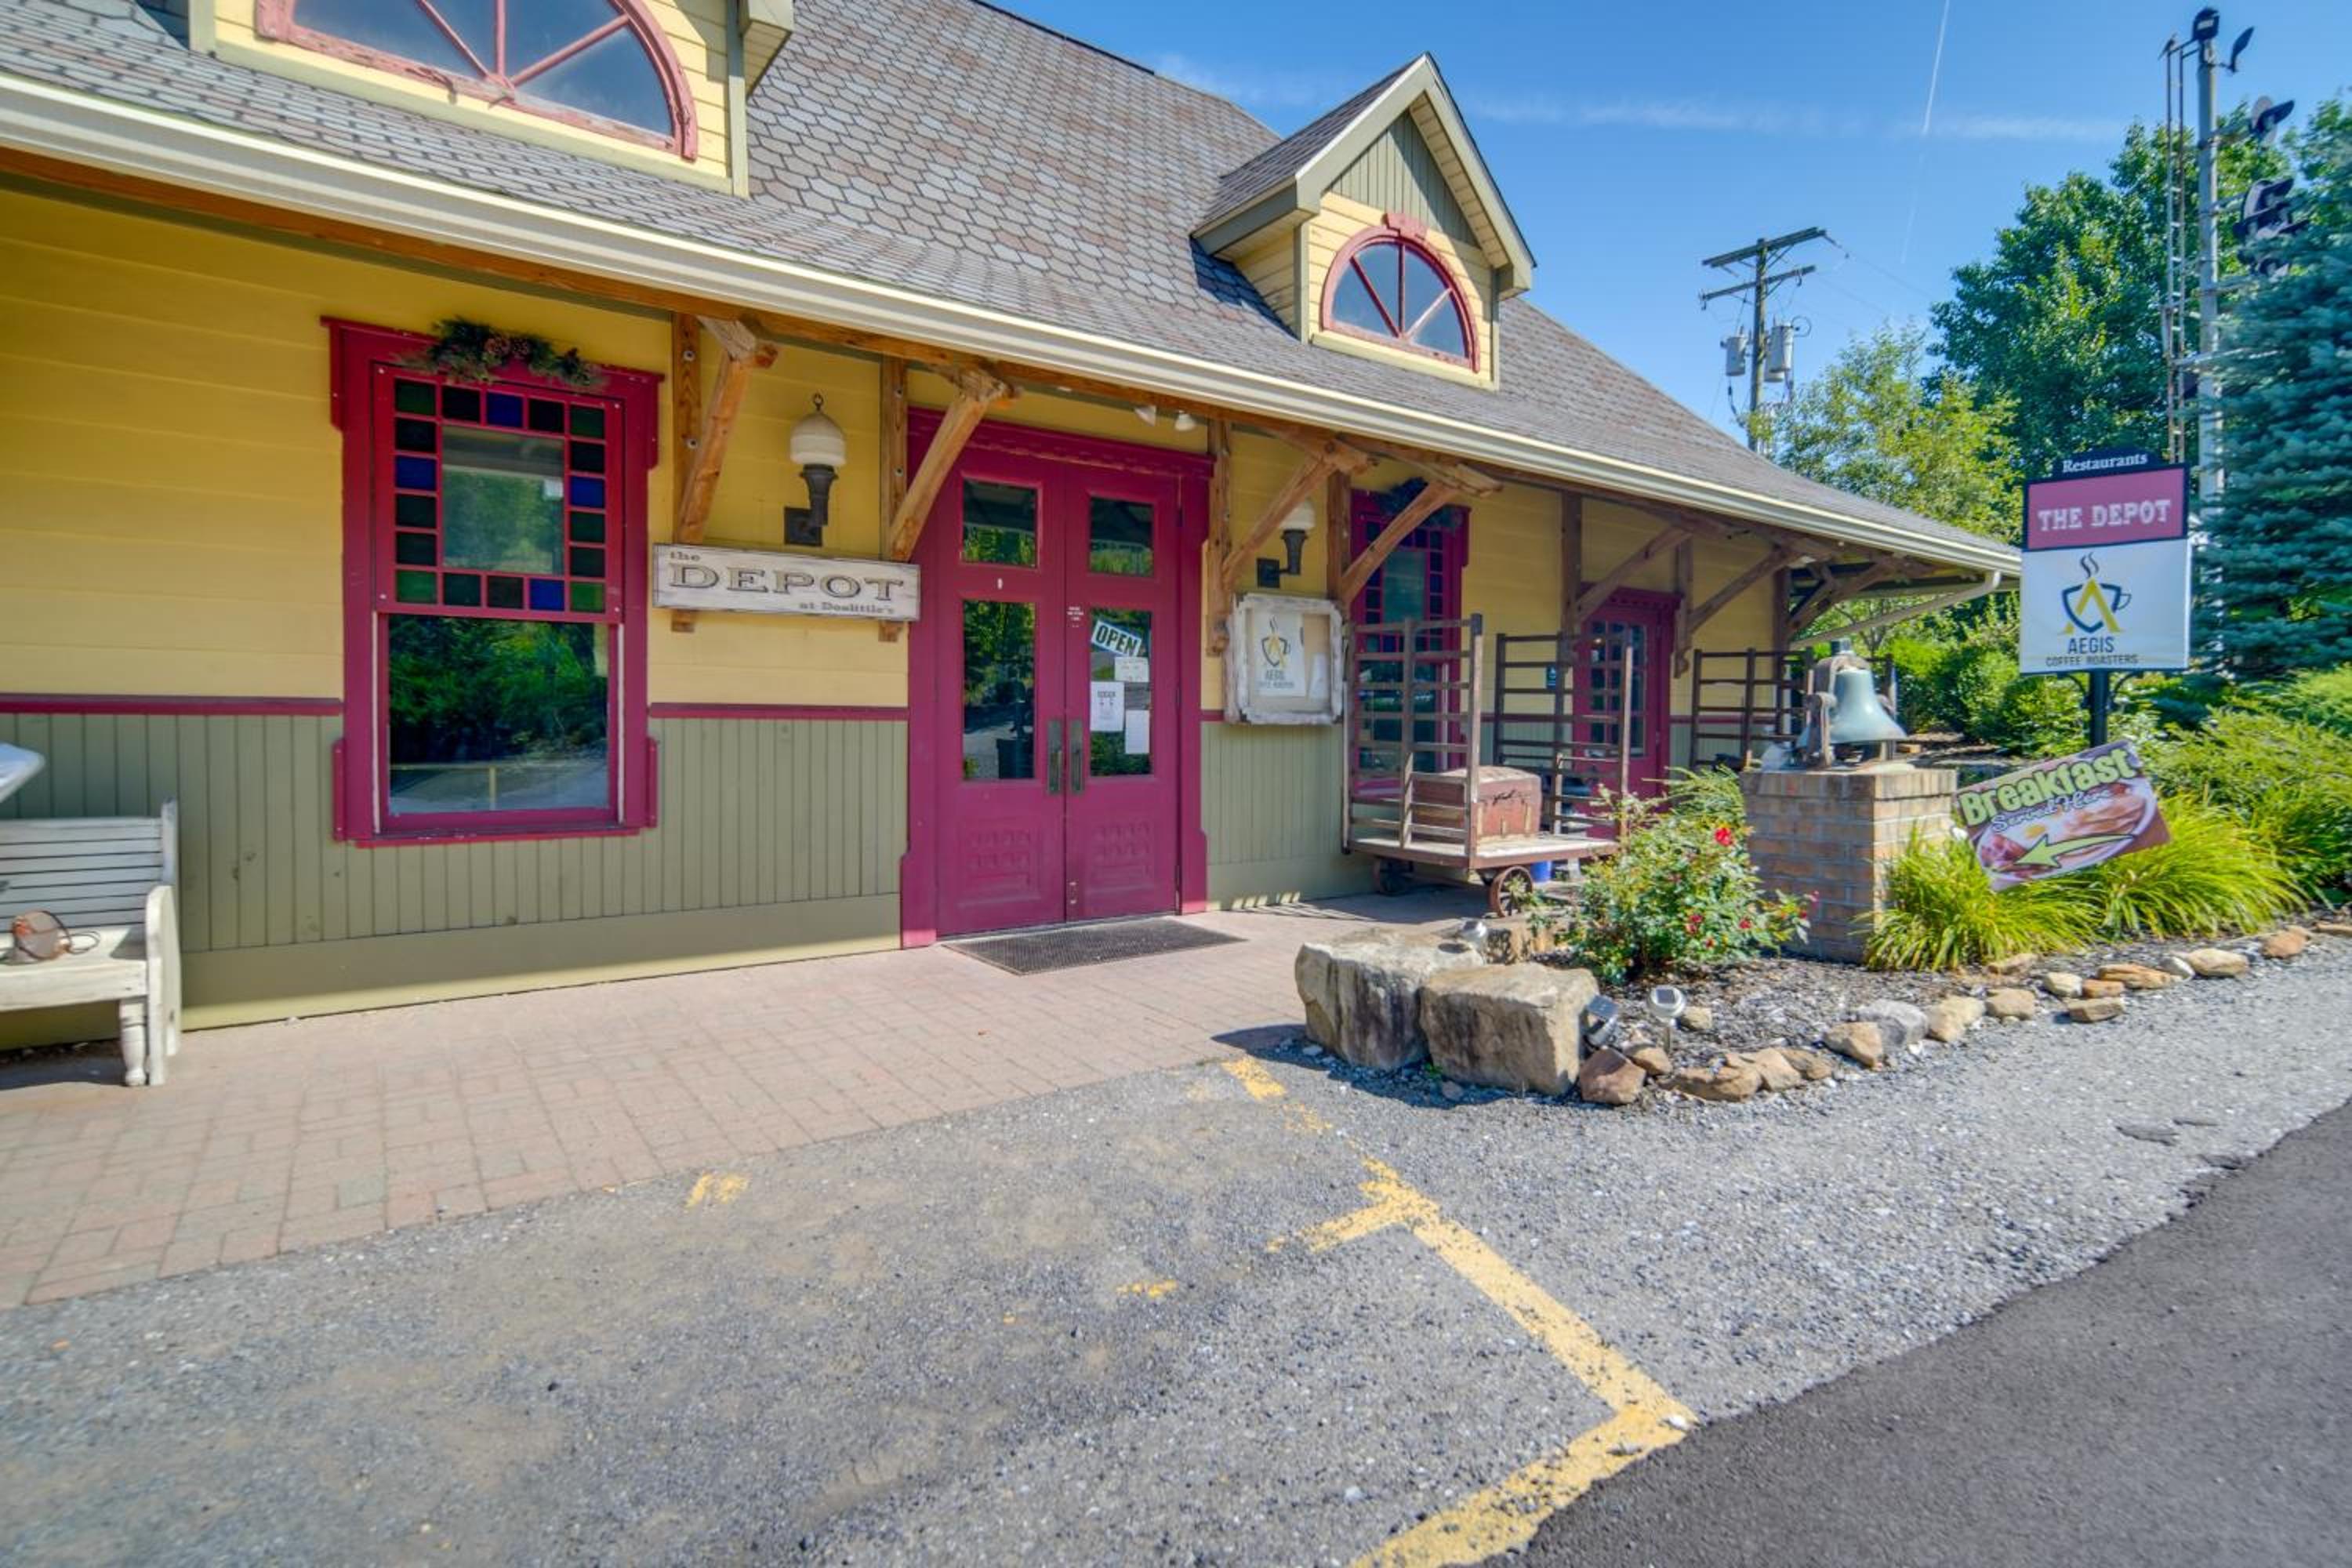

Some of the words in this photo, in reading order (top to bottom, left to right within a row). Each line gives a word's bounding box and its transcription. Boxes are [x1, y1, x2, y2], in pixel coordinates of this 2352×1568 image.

[2063, 452, 2148, 473] Restaurants
[2037, 507, 2083, 532] THE
[2091, 499, 2171, 527] DEPOT
[670, 551, 701, 562] the
[667, 561, 905, 602] DEPOT
[798, 601, 815, 610] at
[1095, 624, 1138, 657] OPEN
[2067, 637, 2115, 655] AEGIS
[2045, 655, 2082, 667] COFFEE
[2085, 653, 2140, 666] ROASTERS
[1958, 748, 2136, 826] Breakfast
